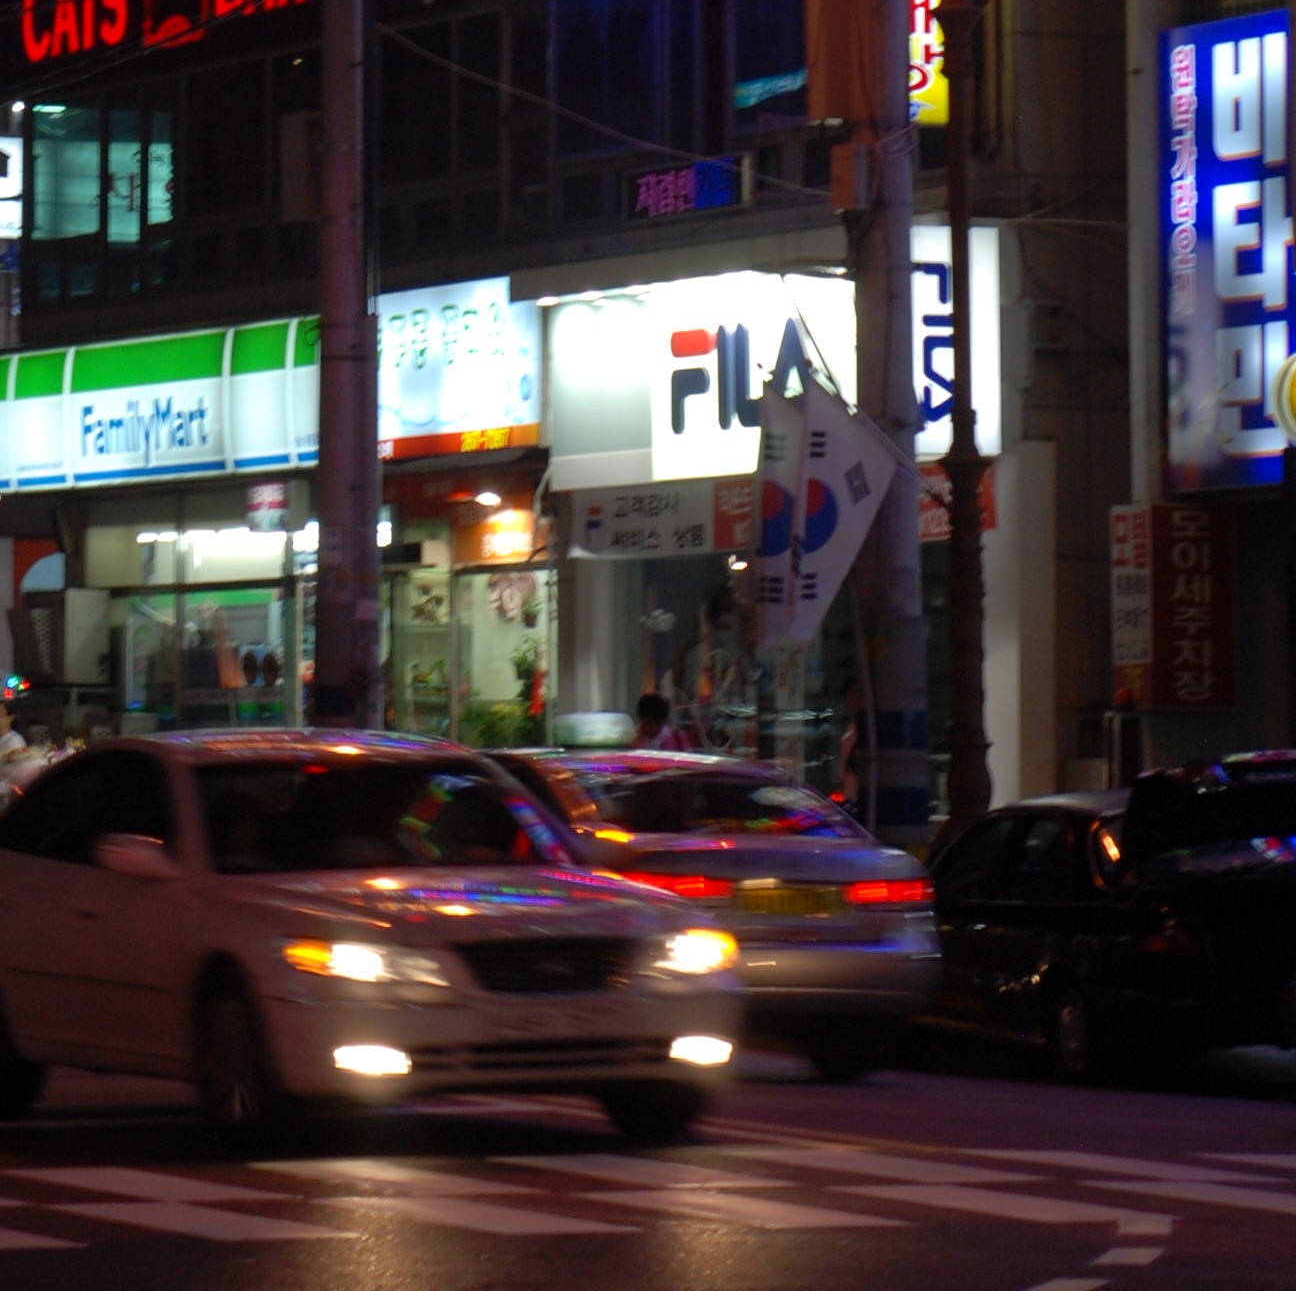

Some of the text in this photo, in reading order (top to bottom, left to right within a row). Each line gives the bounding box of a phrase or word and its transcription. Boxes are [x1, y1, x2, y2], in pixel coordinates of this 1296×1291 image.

[1212, 31, 1296, 457] 비타민
[81, 383, 211, 469] FamilyMart
[670, 317, 811, 435] FILA
